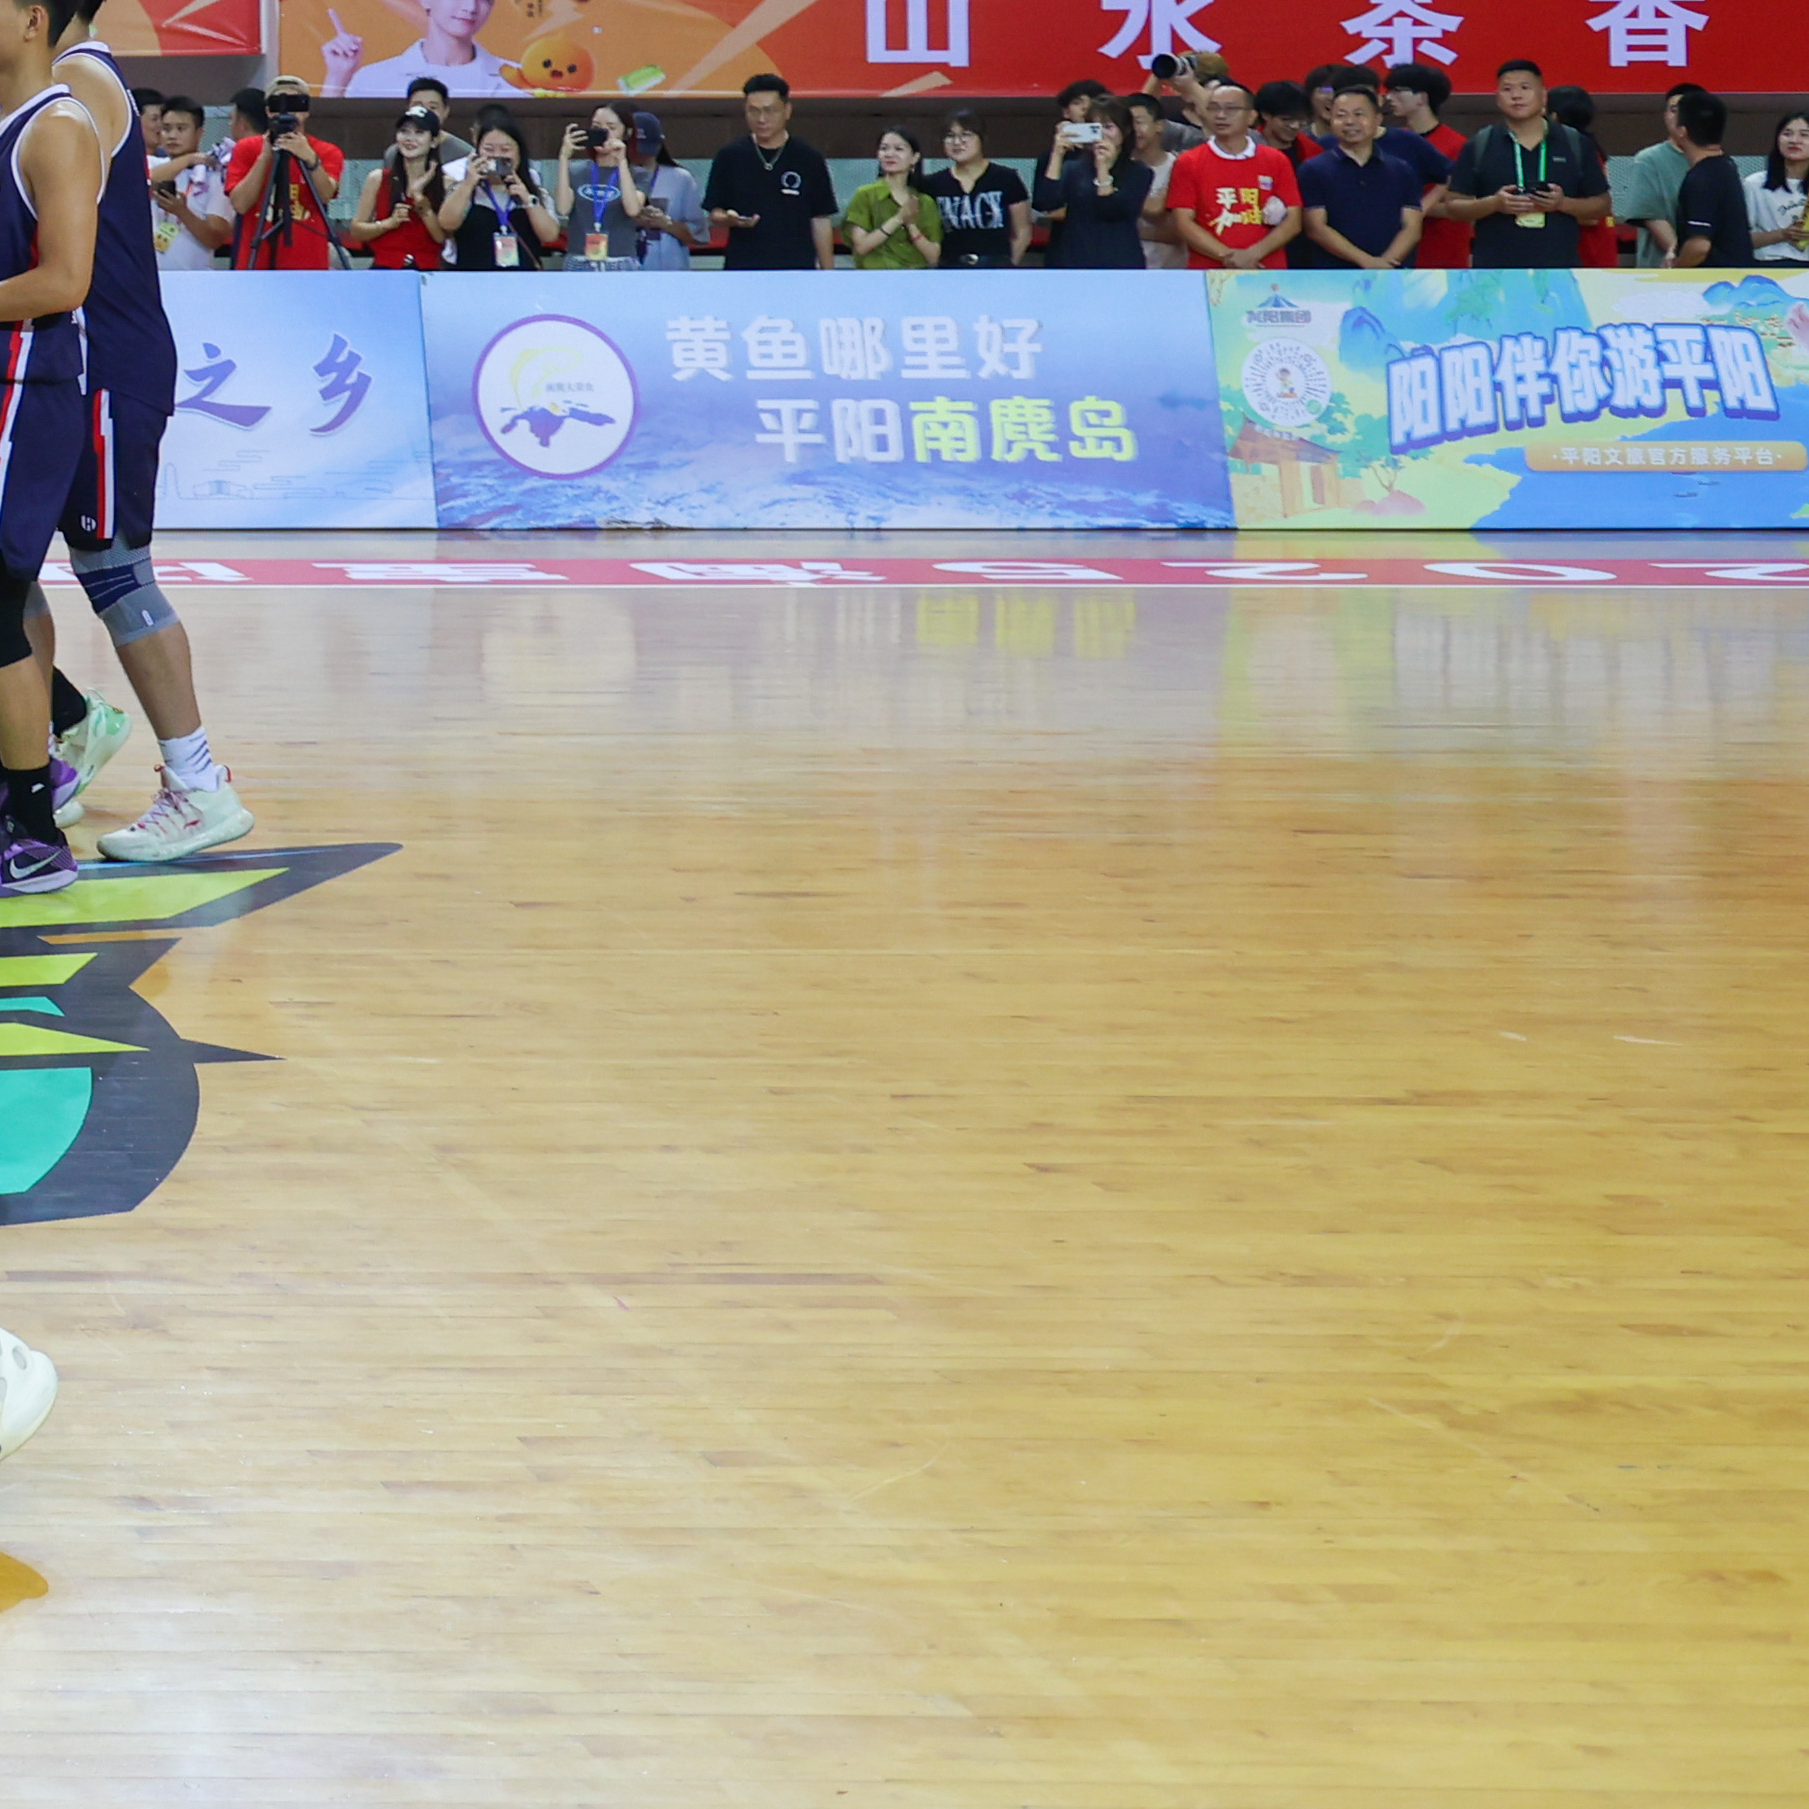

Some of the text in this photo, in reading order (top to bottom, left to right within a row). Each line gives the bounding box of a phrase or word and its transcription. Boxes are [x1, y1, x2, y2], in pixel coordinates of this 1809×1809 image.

[664, 315, 1044, 382] 黄鱼哪里好
[174, 332, 373, 436] 之乡
[1388, 323, 1780, 454] 阳阳伴你游平阳
[754, 395, 1139, 464] 平阳南麂岛
[1560, 446, 1776, 467] 平阳文旅官方服务平台
